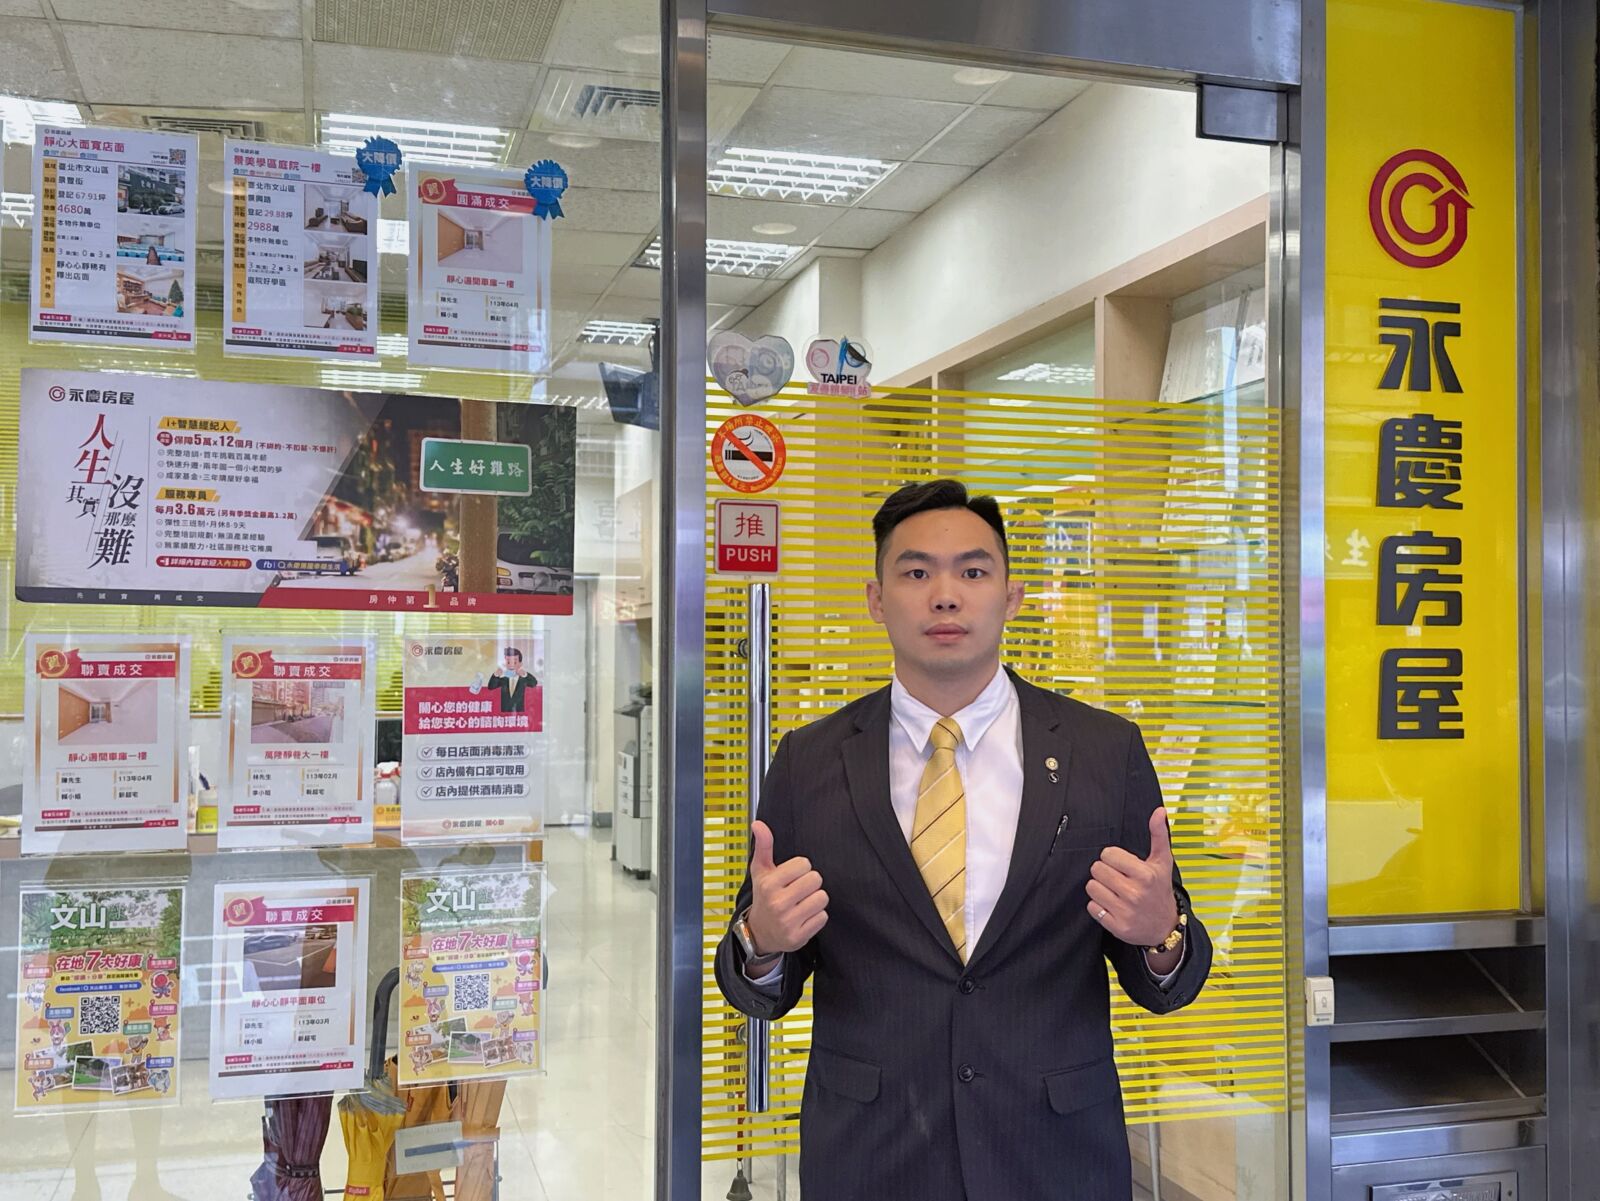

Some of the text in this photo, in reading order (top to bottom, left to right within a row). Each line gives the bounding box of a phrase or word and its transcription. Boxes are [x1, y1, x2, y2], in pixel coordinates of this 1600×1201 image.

[43, 136, 125, 153] 靜心大面寬店面
[59, 163, 109, 174] 臺北市文山區
[234, 155, 320, 172] 景美學區庭院一樓
[248, 182, 295, 193] 臺北市文山區
[457, 194, 510, 209] 圓滿成交
[58, 205, 91, 215] 4680萬
[248, 222, 279, 233] 2988萬
[821, 373, 857, 385] TAIPEI
[69, 388, 134, 405] 永慶房屋
[430, 459, 524, 478] 人生好難路
[156, 503, 215, 517] 每月3.6萬元
[734, 512, 765, 538] 推
[1376, 297, 1465, 739] 永慶房屋
[726, 547, 771, 562] PUSH
[424, 647, 463, 656] 永慶房屋
[81, 663, 142, 676] 聯賣成交
[274, 666, 330, 677] 聯賣成交
[419, 701, 492, 714] 關心您的健康
[419, 716, 529, 730] 給您安心的諮詢環境
[436, 745, 525, 757] 每日店面消毒清潔
[436, 766, 524, 777] 店內備有口罩可取用
[436, 784, 523, 797] 店內提供酒精消毒
[426, 887, 475, 913] 文山
[50, 903, 106, 930] 文山
[265, 910, 323, 922] 聯賣成交
[432, 932, 508, 951] 在地7大好康
[56, 950, 143, 971] 在地7大好康
